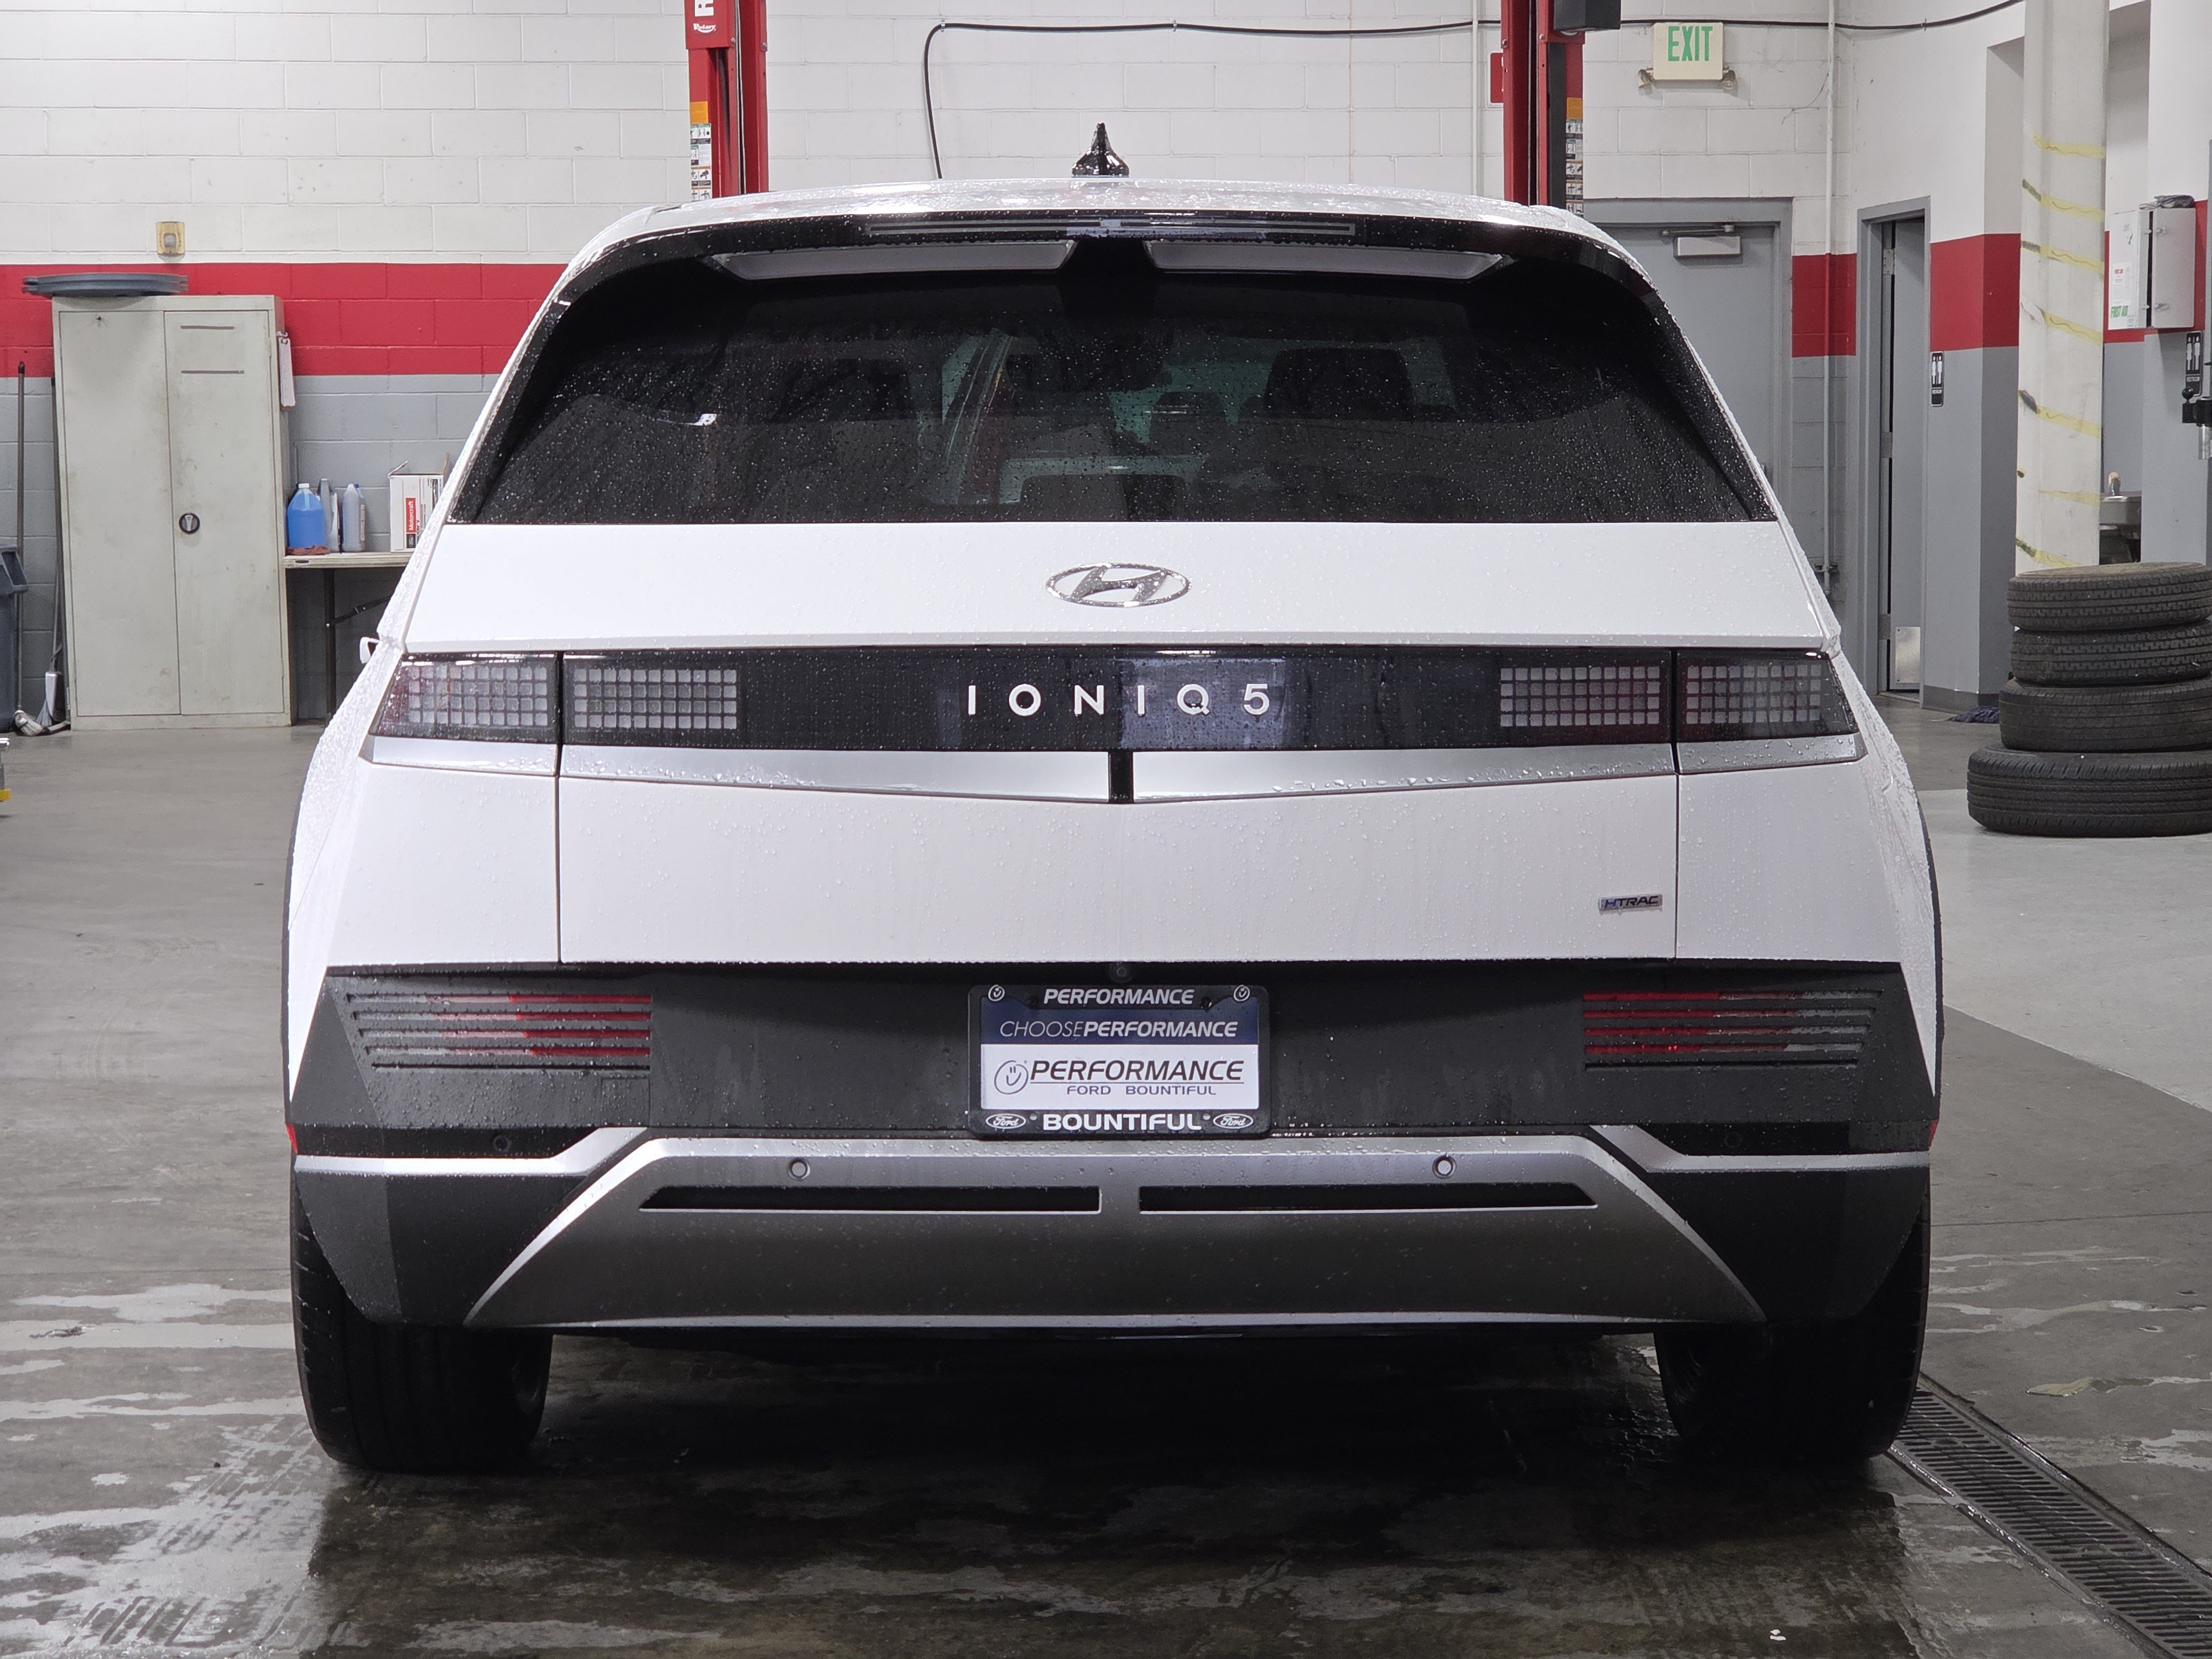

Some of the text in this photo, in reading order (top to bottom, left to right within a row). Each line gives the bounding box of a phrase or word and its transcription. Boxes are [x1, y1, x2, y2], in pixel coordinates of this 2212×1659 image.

[1668, 25, 1713, 61] EXIT
[1605, 895, 1658, 909] HTRAC
[1044, 989, 1194, 1005] PERFORMANCE
[1000, 1021, 1238, 1037] CHOOSEPERFORMANCE
[1030, 1060, 1245, 1081] PERFORMANCE
[1067, 1085, 1217, 1095] FORD BOUNTIFUL
[993, 1115, 1019, 1126] Ford
[1043, 1113, 1202, 1131] BOUNTIFUL
[1220, 1115, 1246, 1126] Ford
